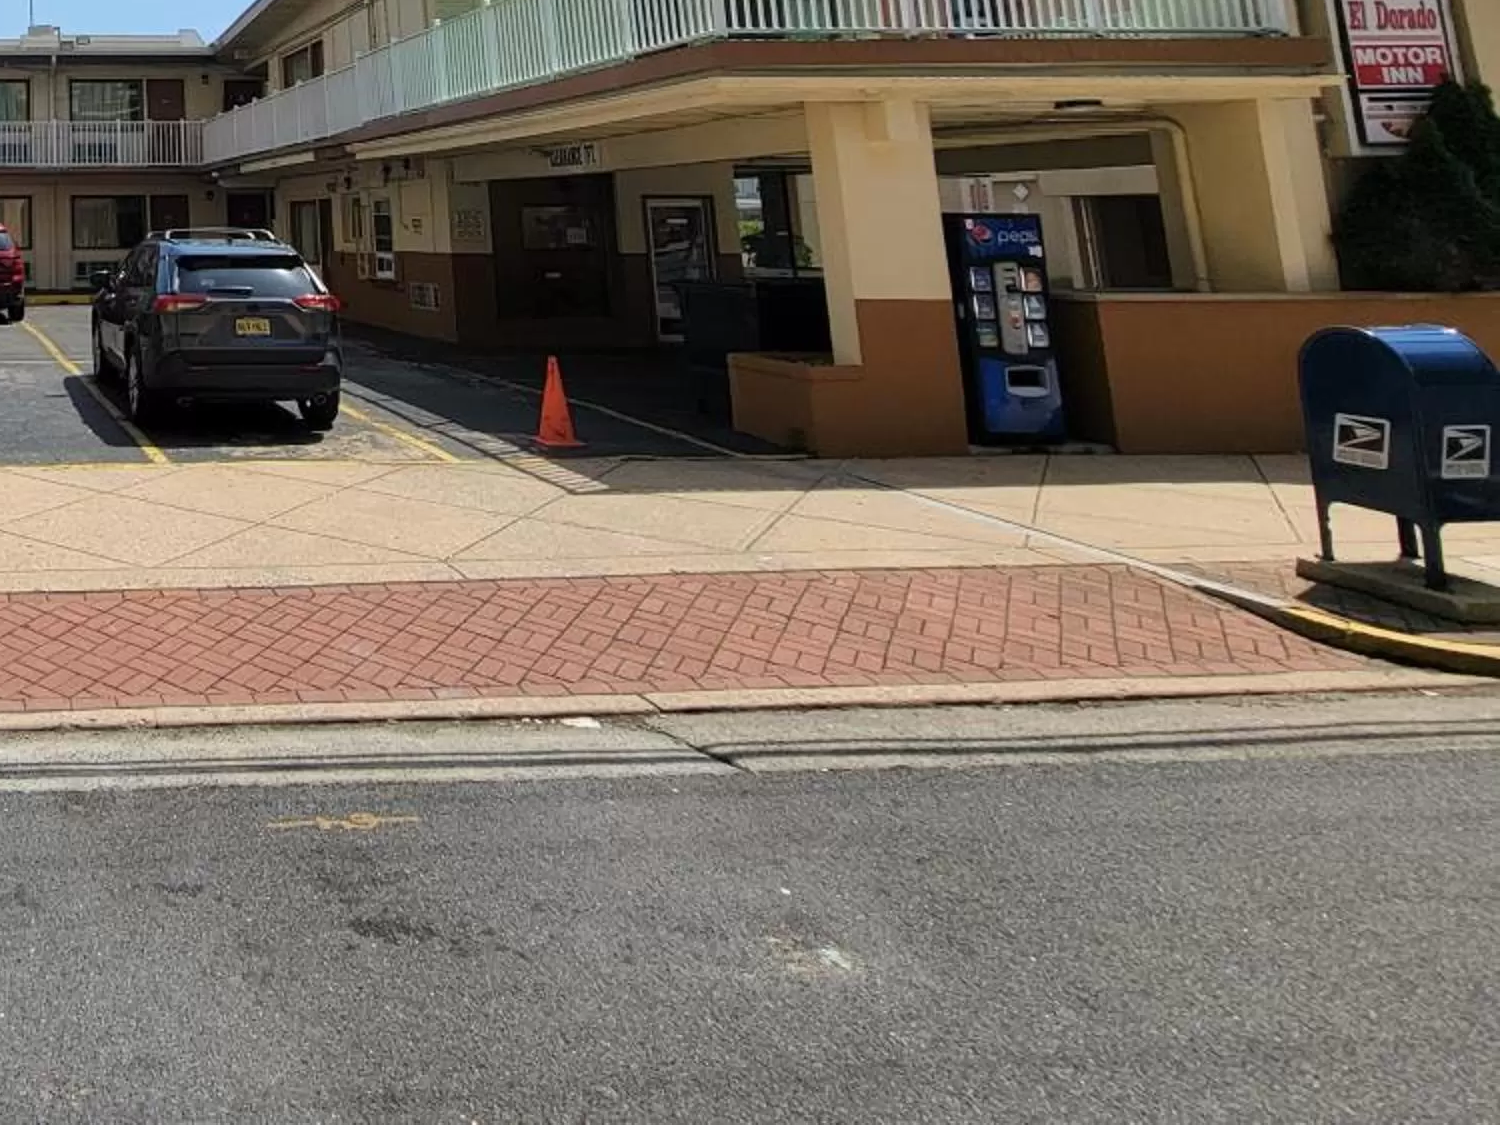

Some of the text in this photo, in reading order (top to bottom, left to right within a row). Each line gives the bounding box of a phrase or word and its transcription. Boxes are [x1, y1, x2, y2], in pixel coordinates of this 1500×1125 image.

[1348, 0, 1437, 30] El Dorado
[1355, 47, 1443, 65] MOTOR
[1381, 66, 1424, 83] INN
